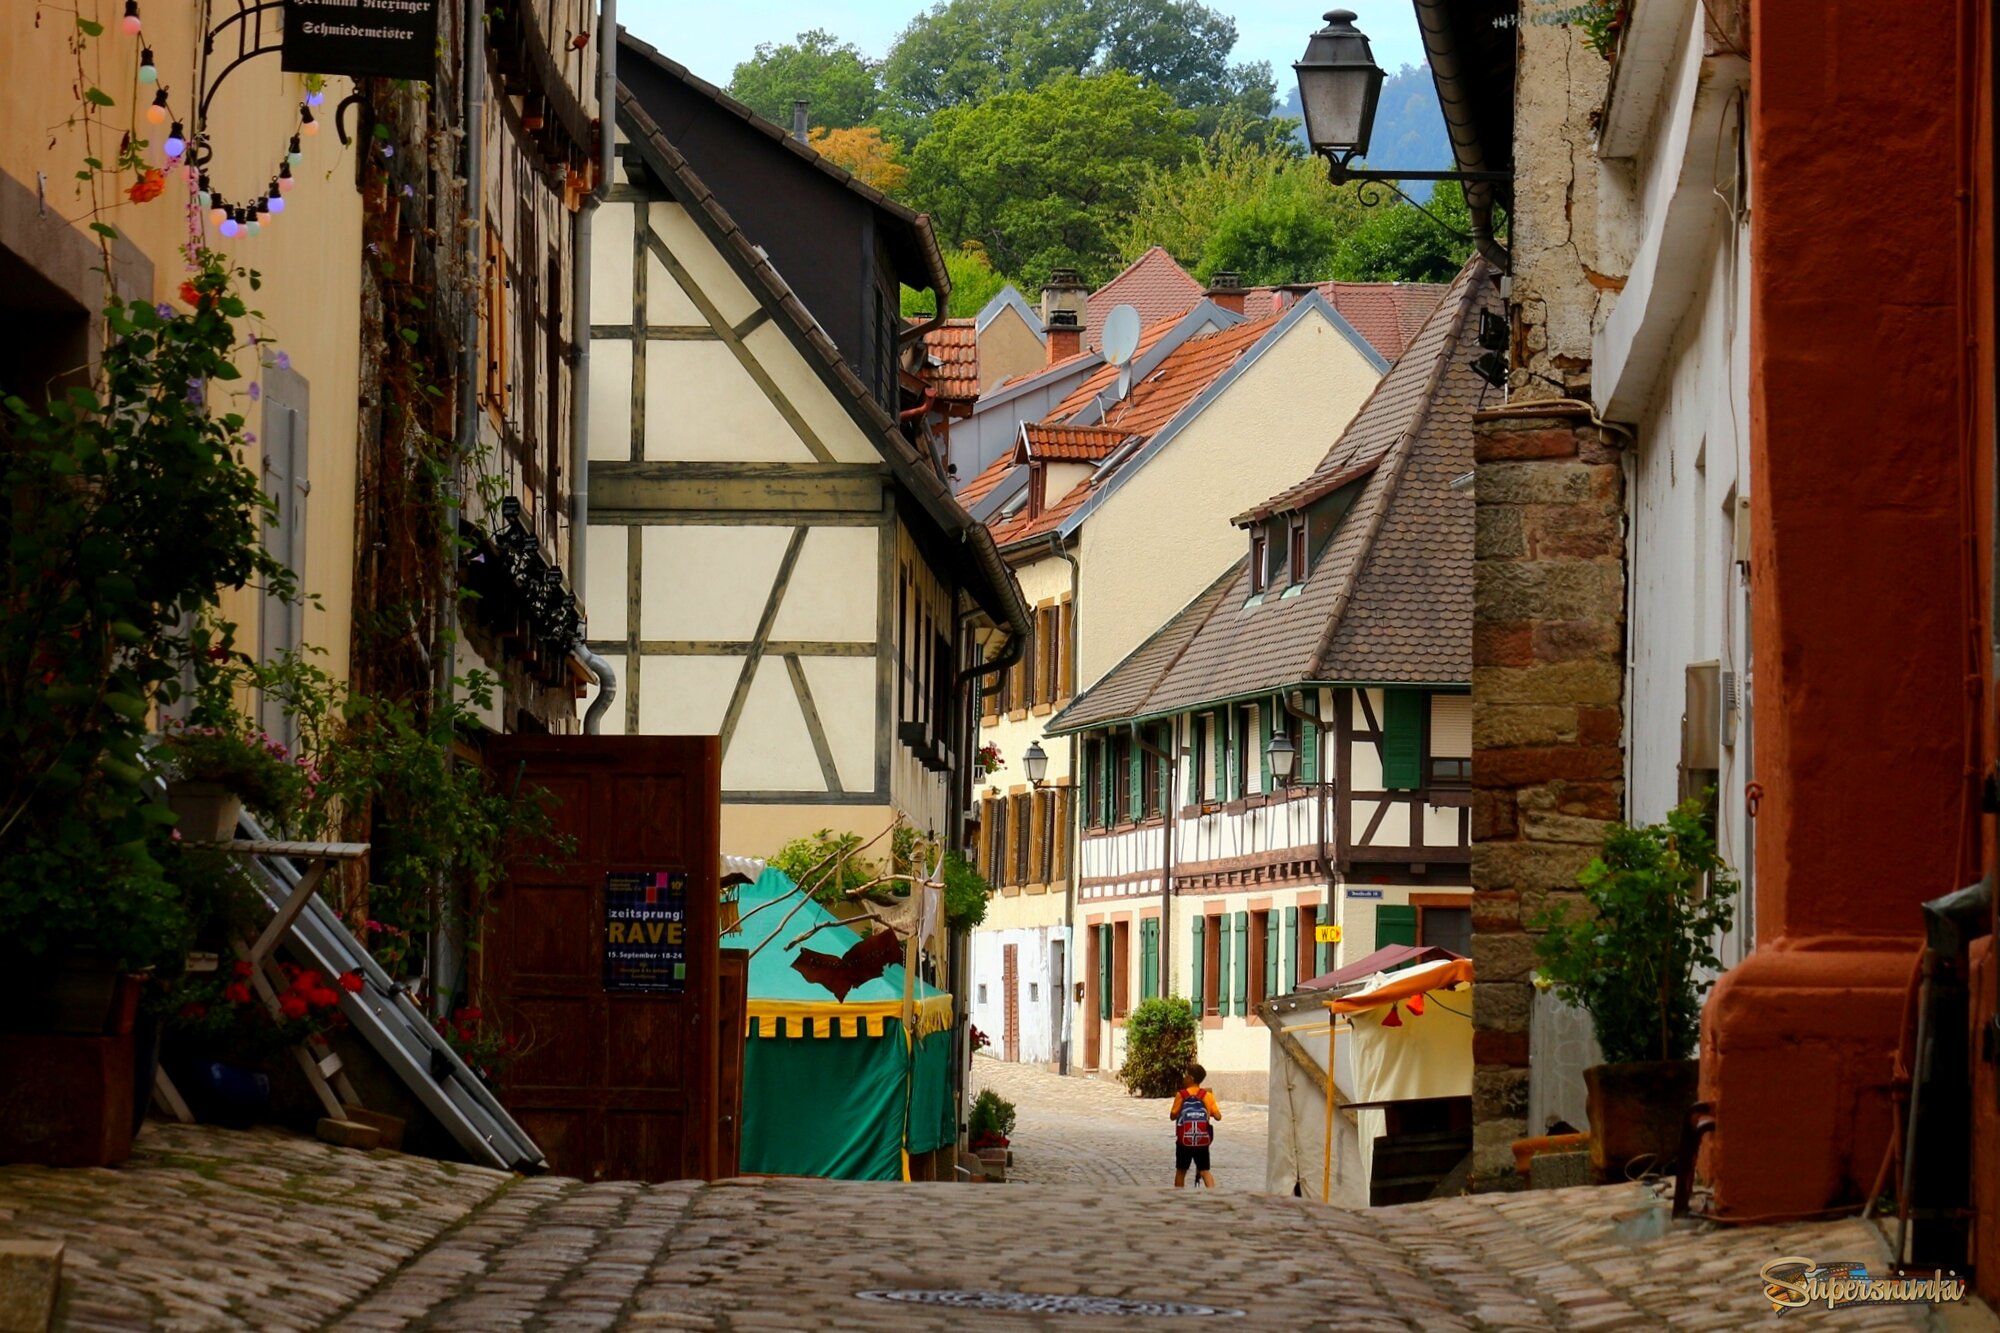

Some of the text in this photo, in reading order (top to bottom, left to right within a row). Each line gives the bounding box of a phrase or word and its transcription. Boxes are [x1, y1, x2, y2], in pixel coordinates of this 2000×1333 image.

[303, 21, 414, 39] Schmiedemeister
[609, 922, 682, 944] RAVE
[1321, 929, 1335, 940] WC
[620, 951, 657, 960] September
